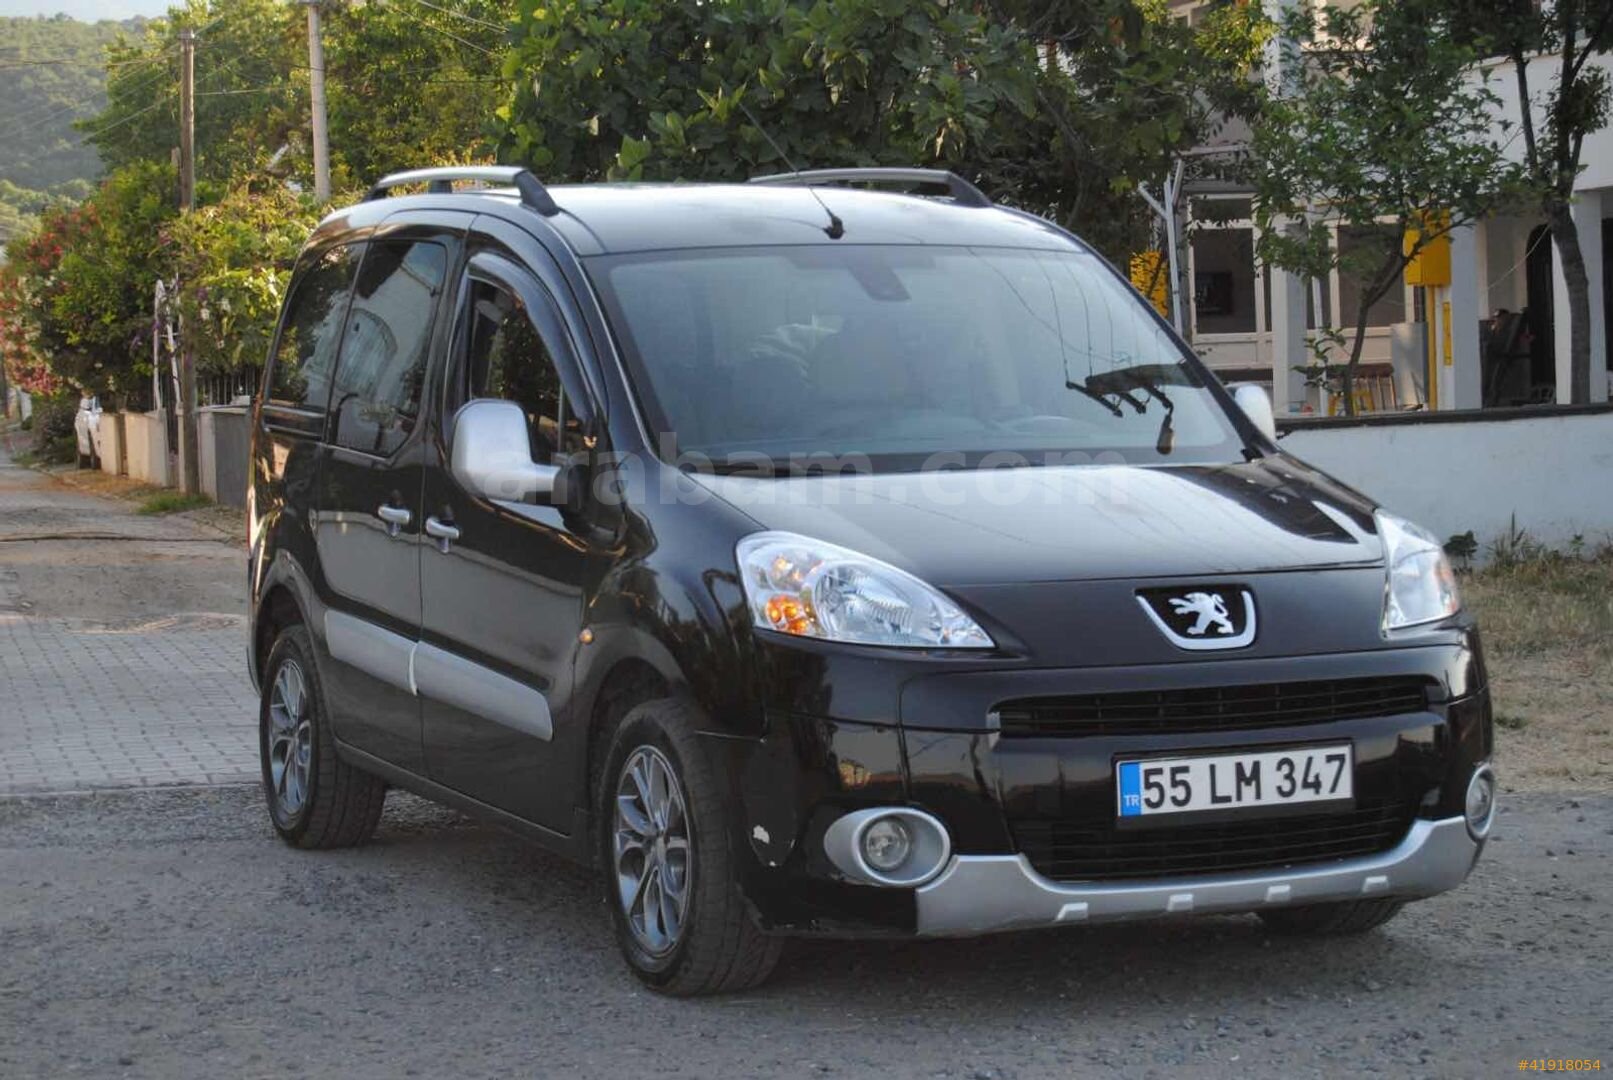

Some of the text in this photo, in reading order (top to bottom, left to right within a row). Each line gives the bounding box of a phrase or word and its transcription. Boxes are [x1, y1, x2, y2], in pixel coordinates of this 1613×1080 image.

[1143, 753, 1346, 809] 55 LM 347
[1124, 795, 1140, 807] TR
